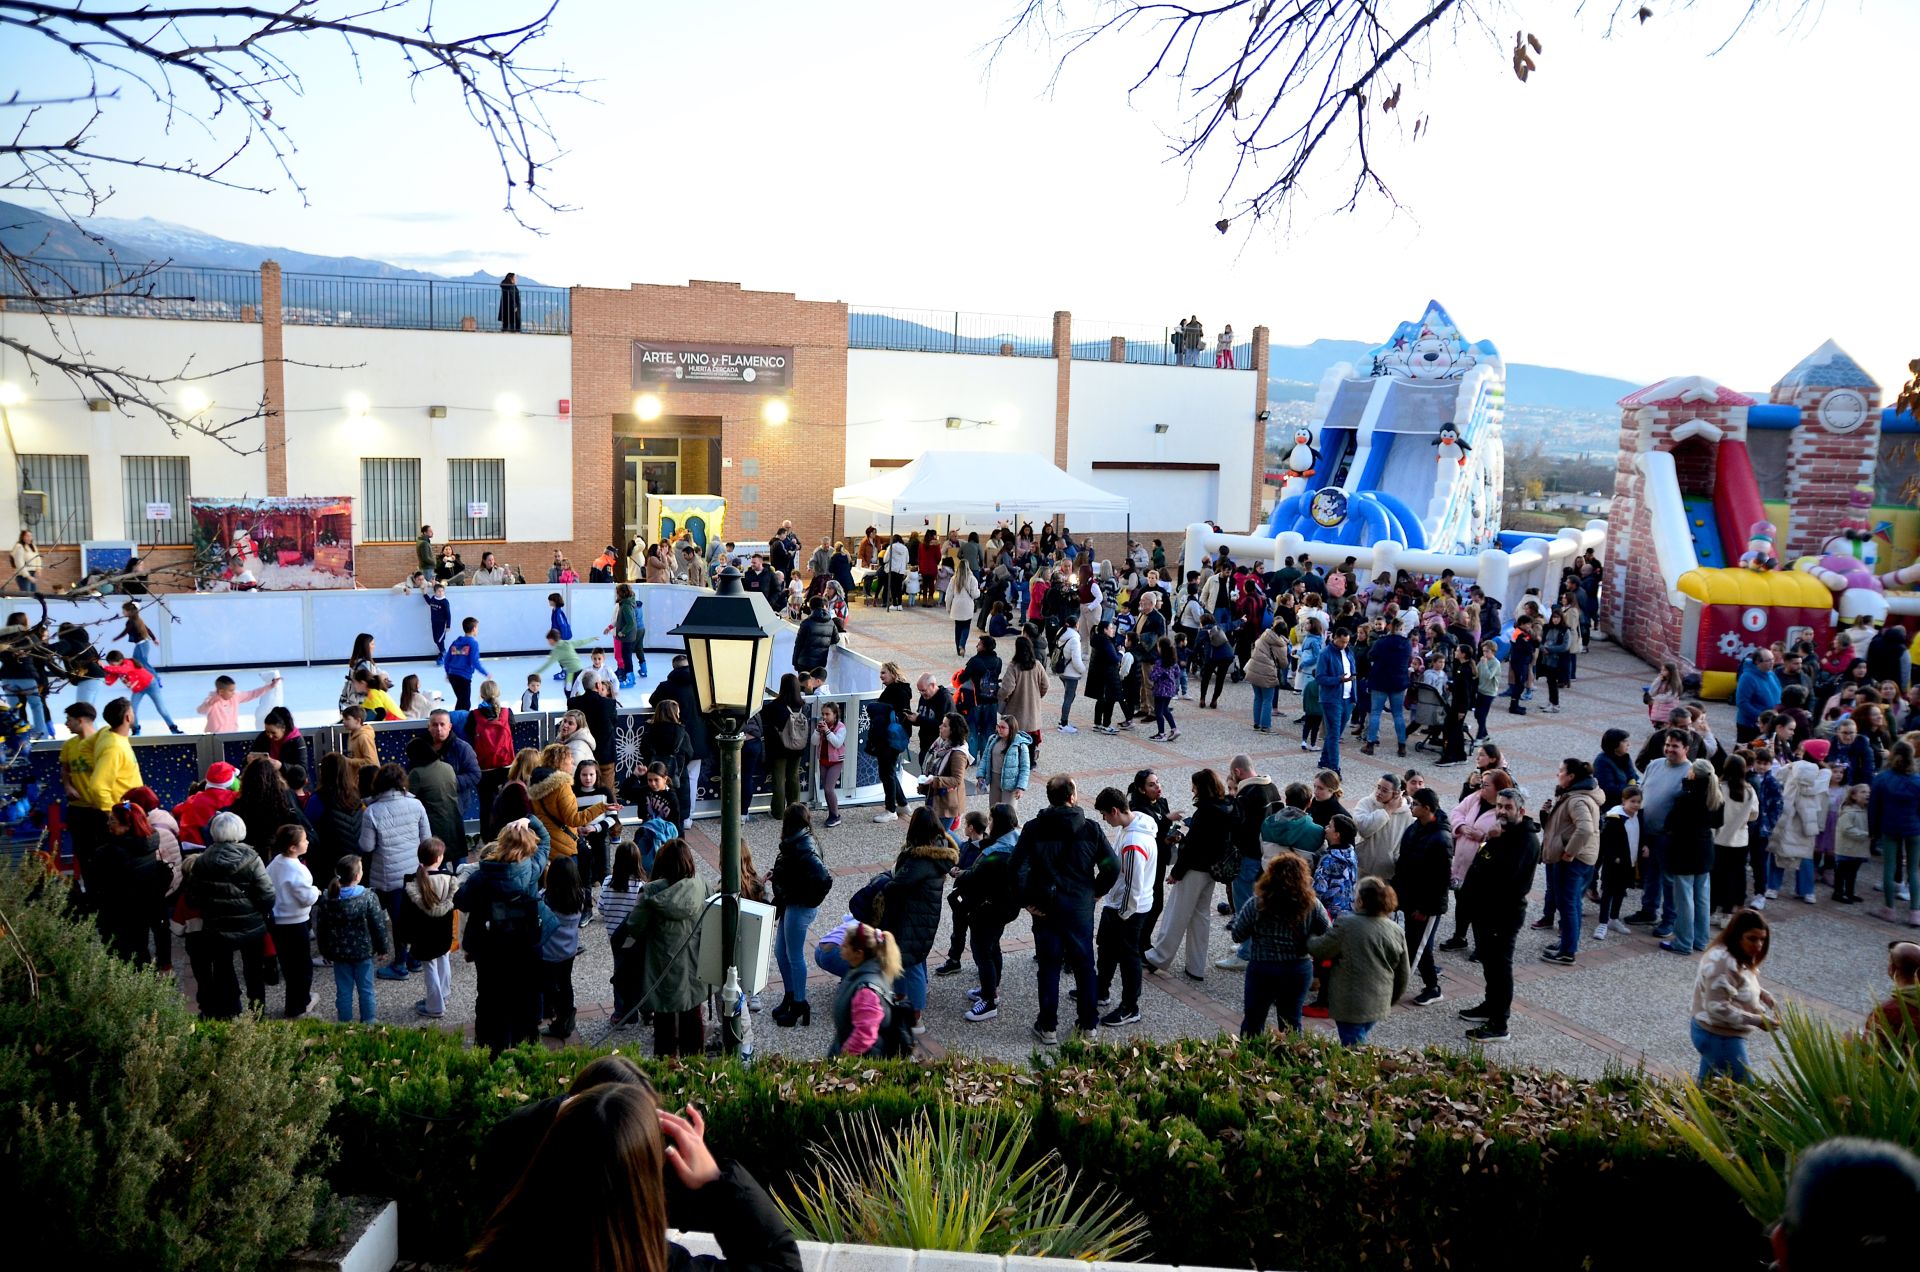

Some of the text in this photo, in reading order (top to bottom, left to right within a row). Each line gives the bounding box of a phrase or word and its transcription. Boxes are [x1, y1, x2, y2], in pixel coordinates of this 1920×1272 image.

[642, 351, 785, 368] ARTE, VINO y FLAMENCO
